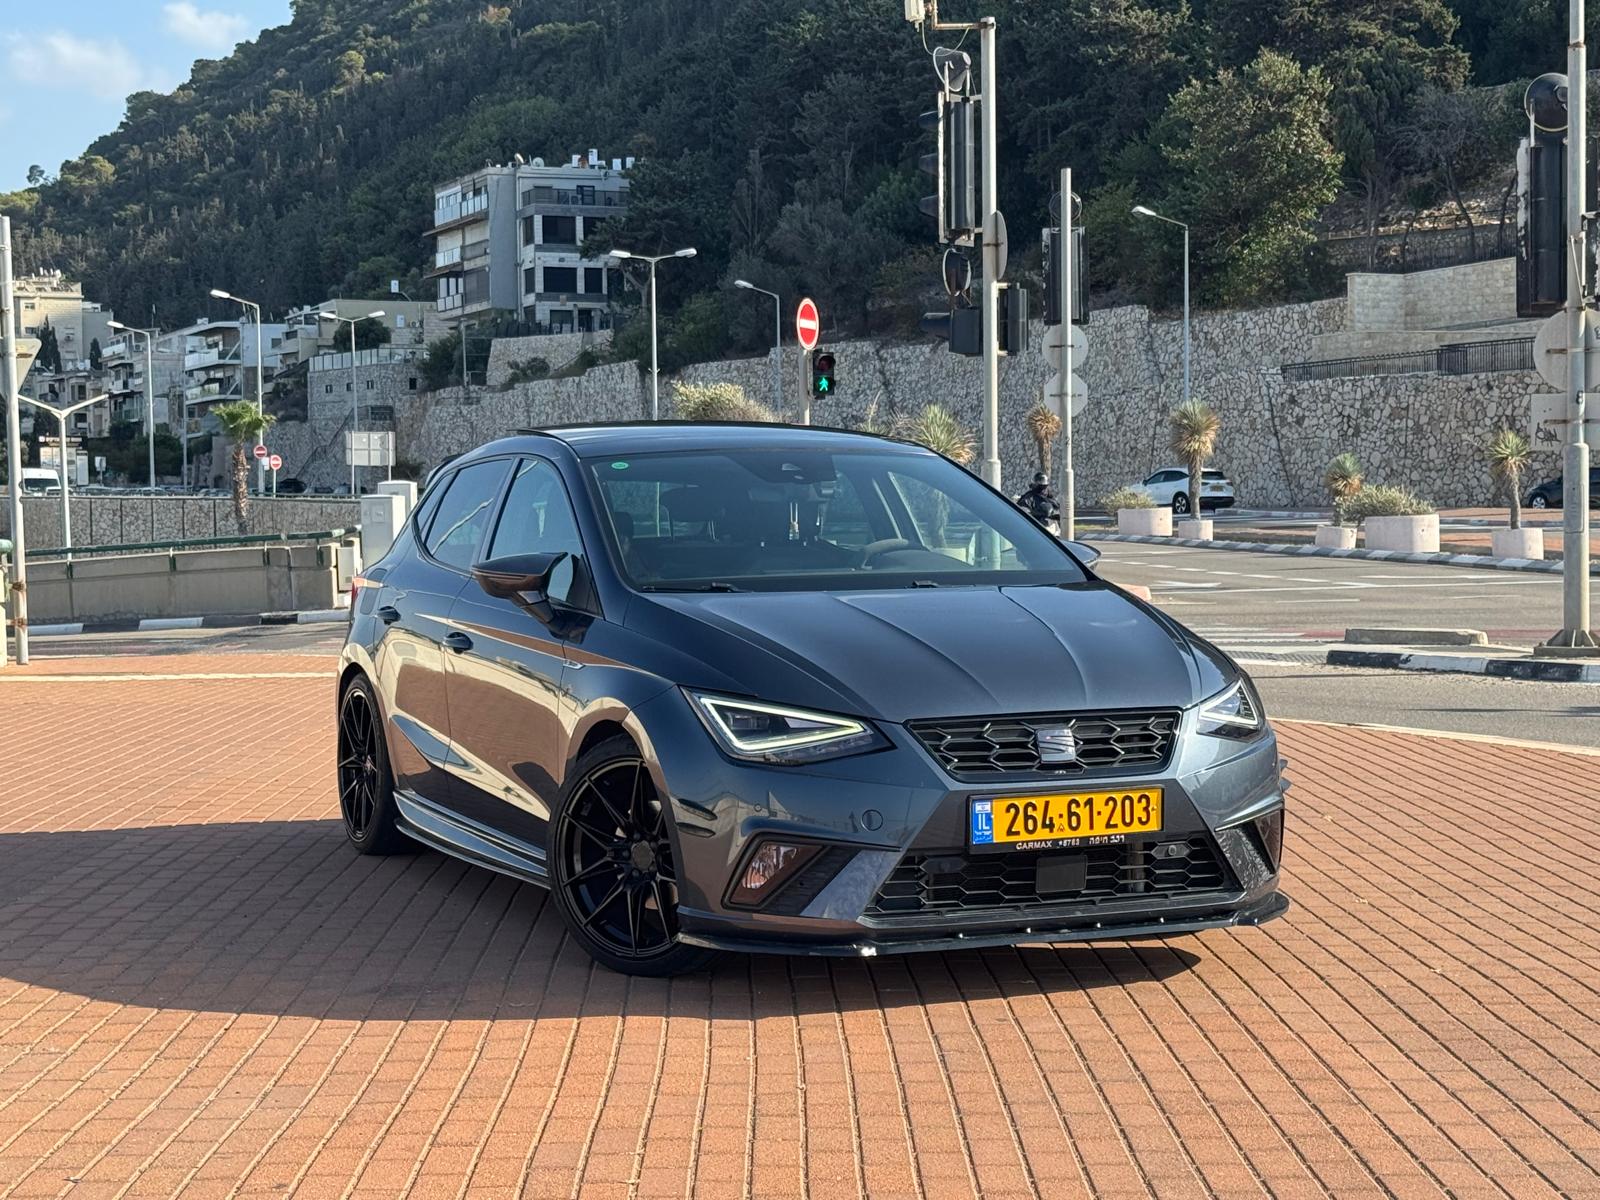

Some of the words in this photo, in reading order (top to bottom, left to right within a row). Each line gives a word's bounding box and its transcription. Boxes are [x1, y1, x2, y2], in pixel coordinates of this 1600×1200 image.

[978, 813, 990, 830] IL
[1088, 836, 1108, 845] חיפה
[1016, 841, 1052, 850] CARMAX
